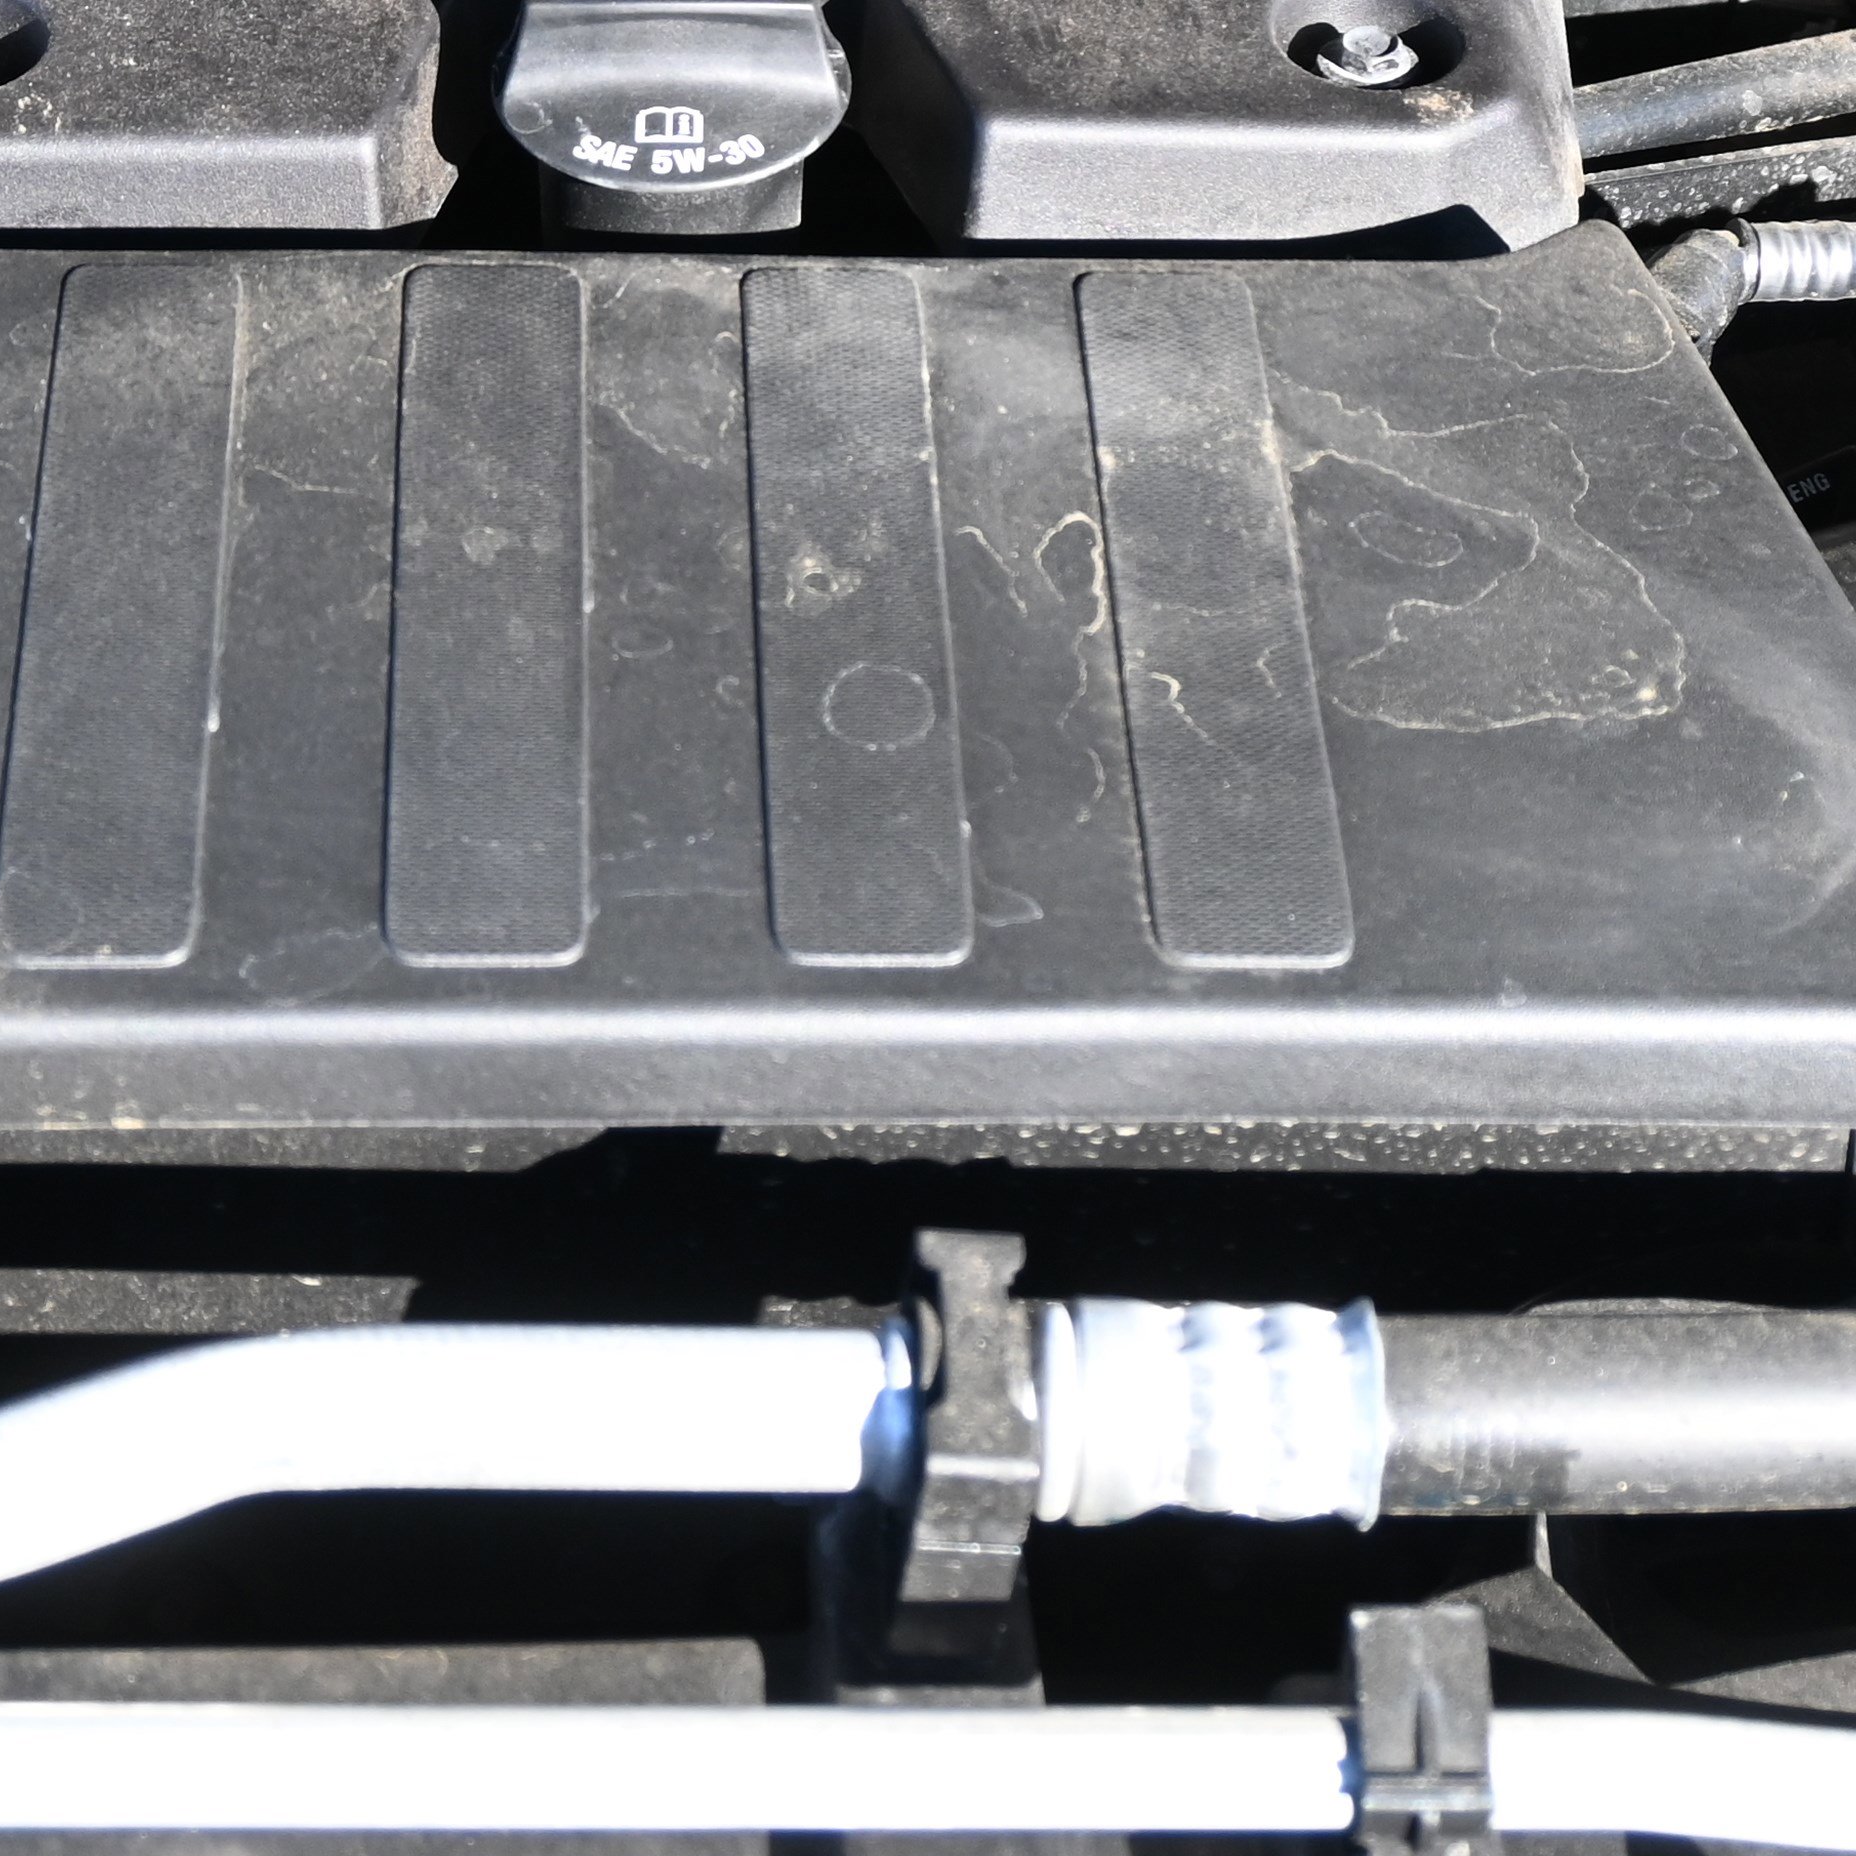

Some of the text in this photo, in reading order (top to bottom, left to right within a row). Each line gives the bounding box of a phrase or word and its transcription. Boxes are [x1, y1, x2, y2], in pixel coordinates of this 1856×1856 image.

[572, 133, 766, 175] SAE 5W-30
[1787, 473, 1831, 503] ENG
